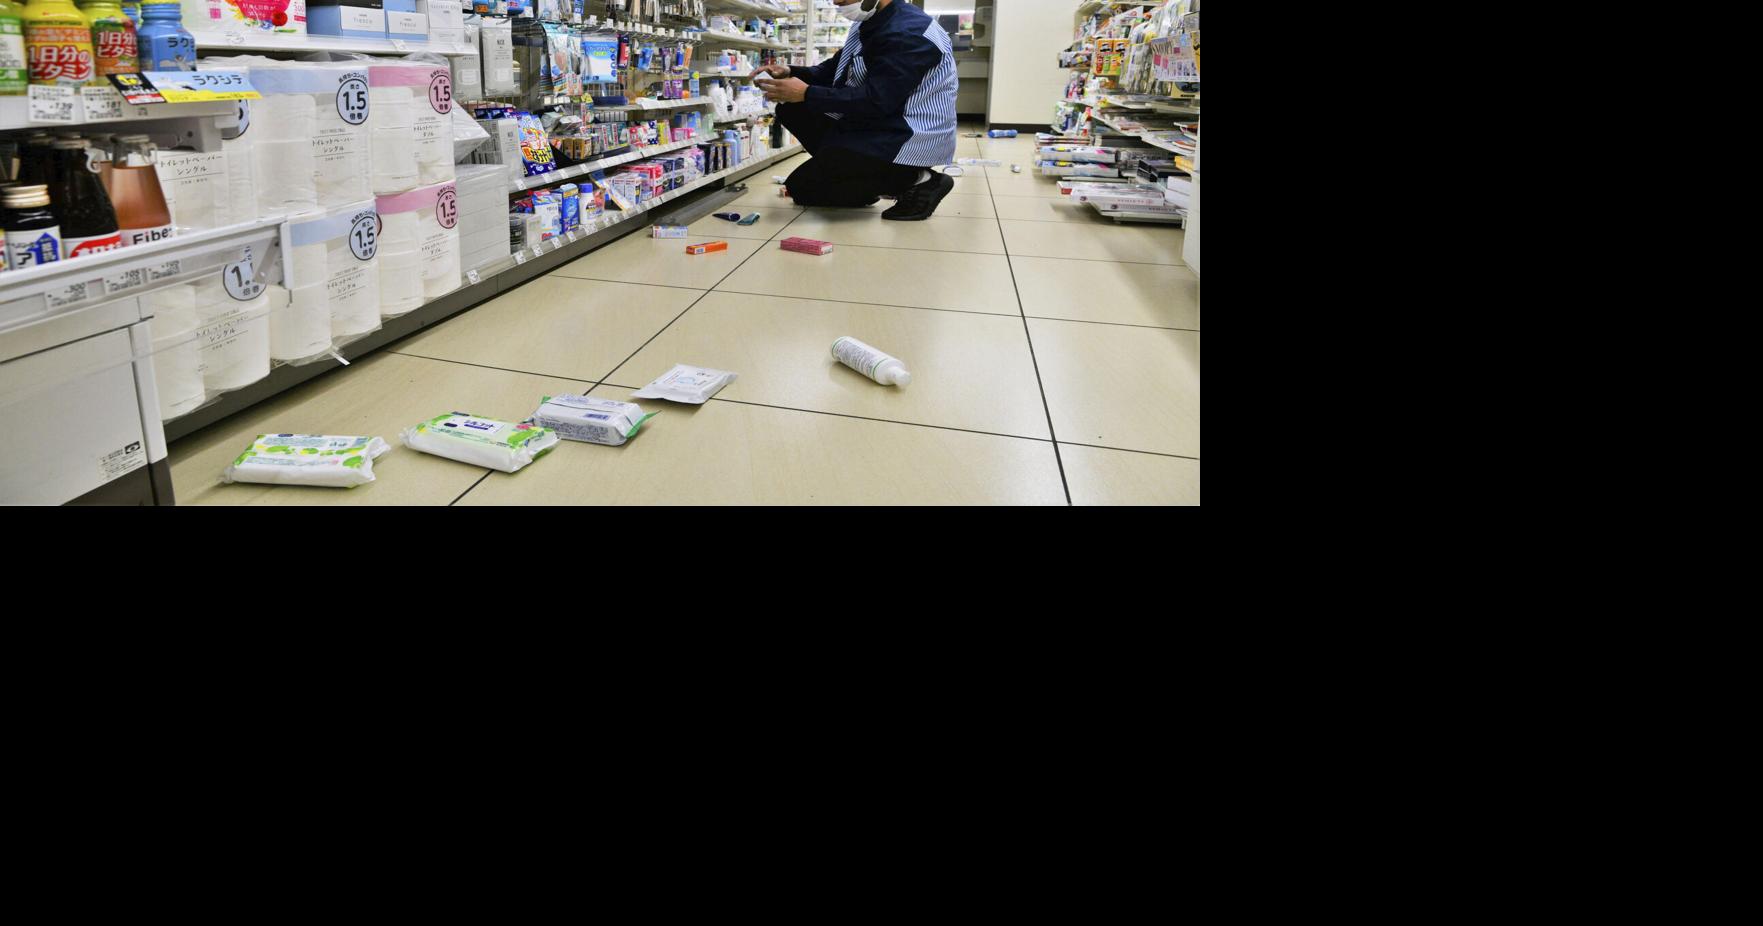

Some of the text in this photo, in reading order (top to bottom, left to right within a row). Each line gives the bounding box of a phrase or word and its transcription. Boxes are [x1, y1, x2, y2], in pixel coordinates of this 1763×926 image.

[29, 46, 90, 63] 1日分の
[29, 62, 90, 79] ビタミン
[192, 74, 242, 86] ラクシテ
[343, 91, 366, 111] 1.5
[433, 85, 451, 102] 1.5
[312, 137, 353, 147] トイレットペーパー
[160, 154, 223, 168] トイレットペーパー
[177, 165, 208, 176] シングル
[440, 199, 456, 218] 1.5
[355, 226, 375, 248] 1.5
